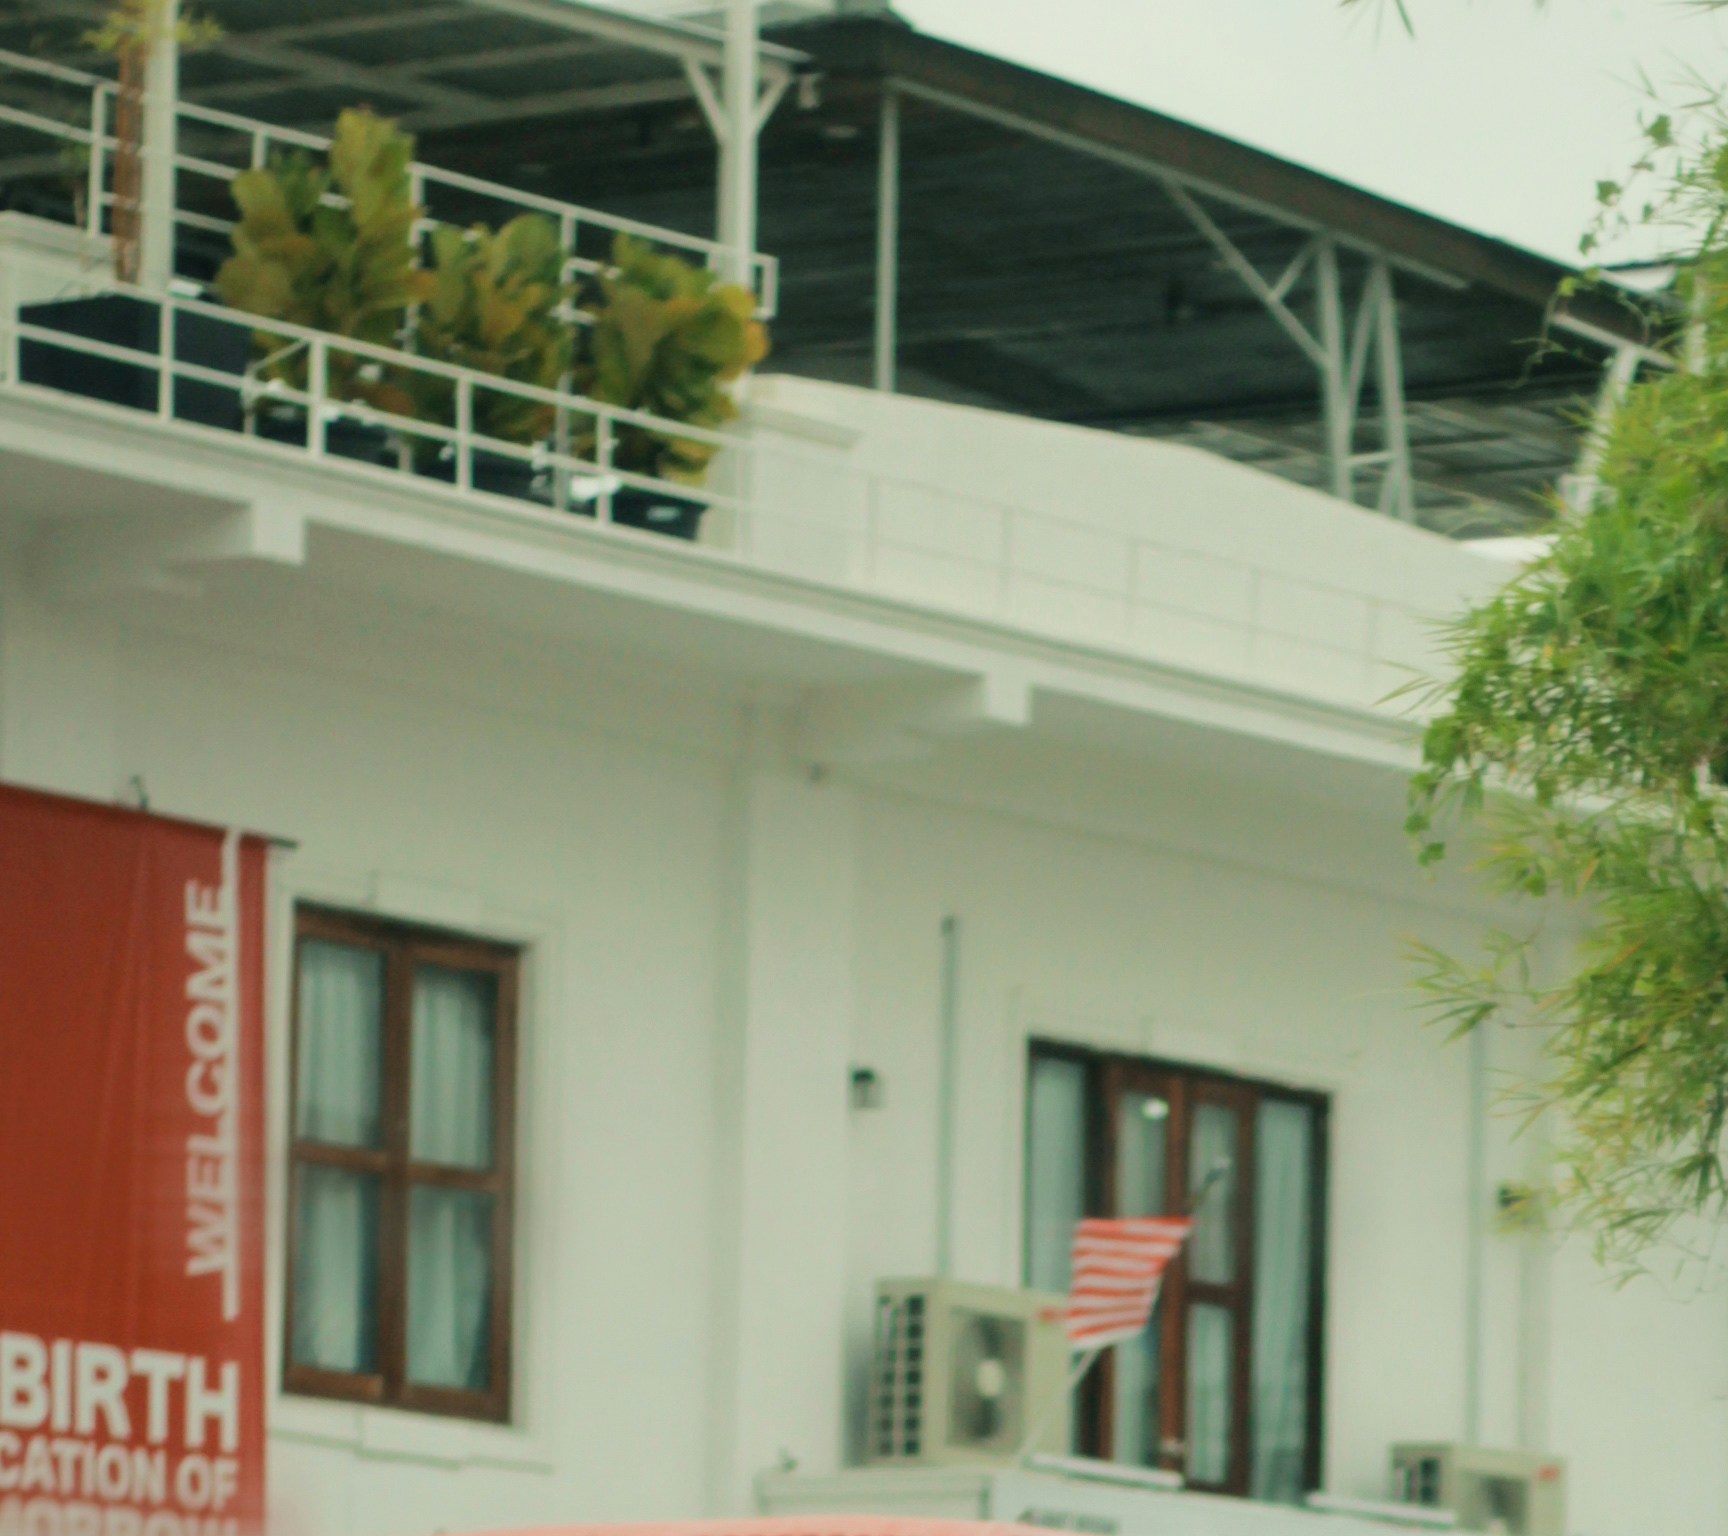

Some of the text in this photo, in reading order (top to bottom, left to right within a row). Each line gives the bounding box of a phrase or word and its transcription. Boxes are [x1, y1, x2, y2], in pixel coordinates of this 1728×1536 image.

[184, 878, 227, 1277] WELCOME
[0, 1330, 239, 1453] BIRTH
[176, 1454, 238, 1511] OF
